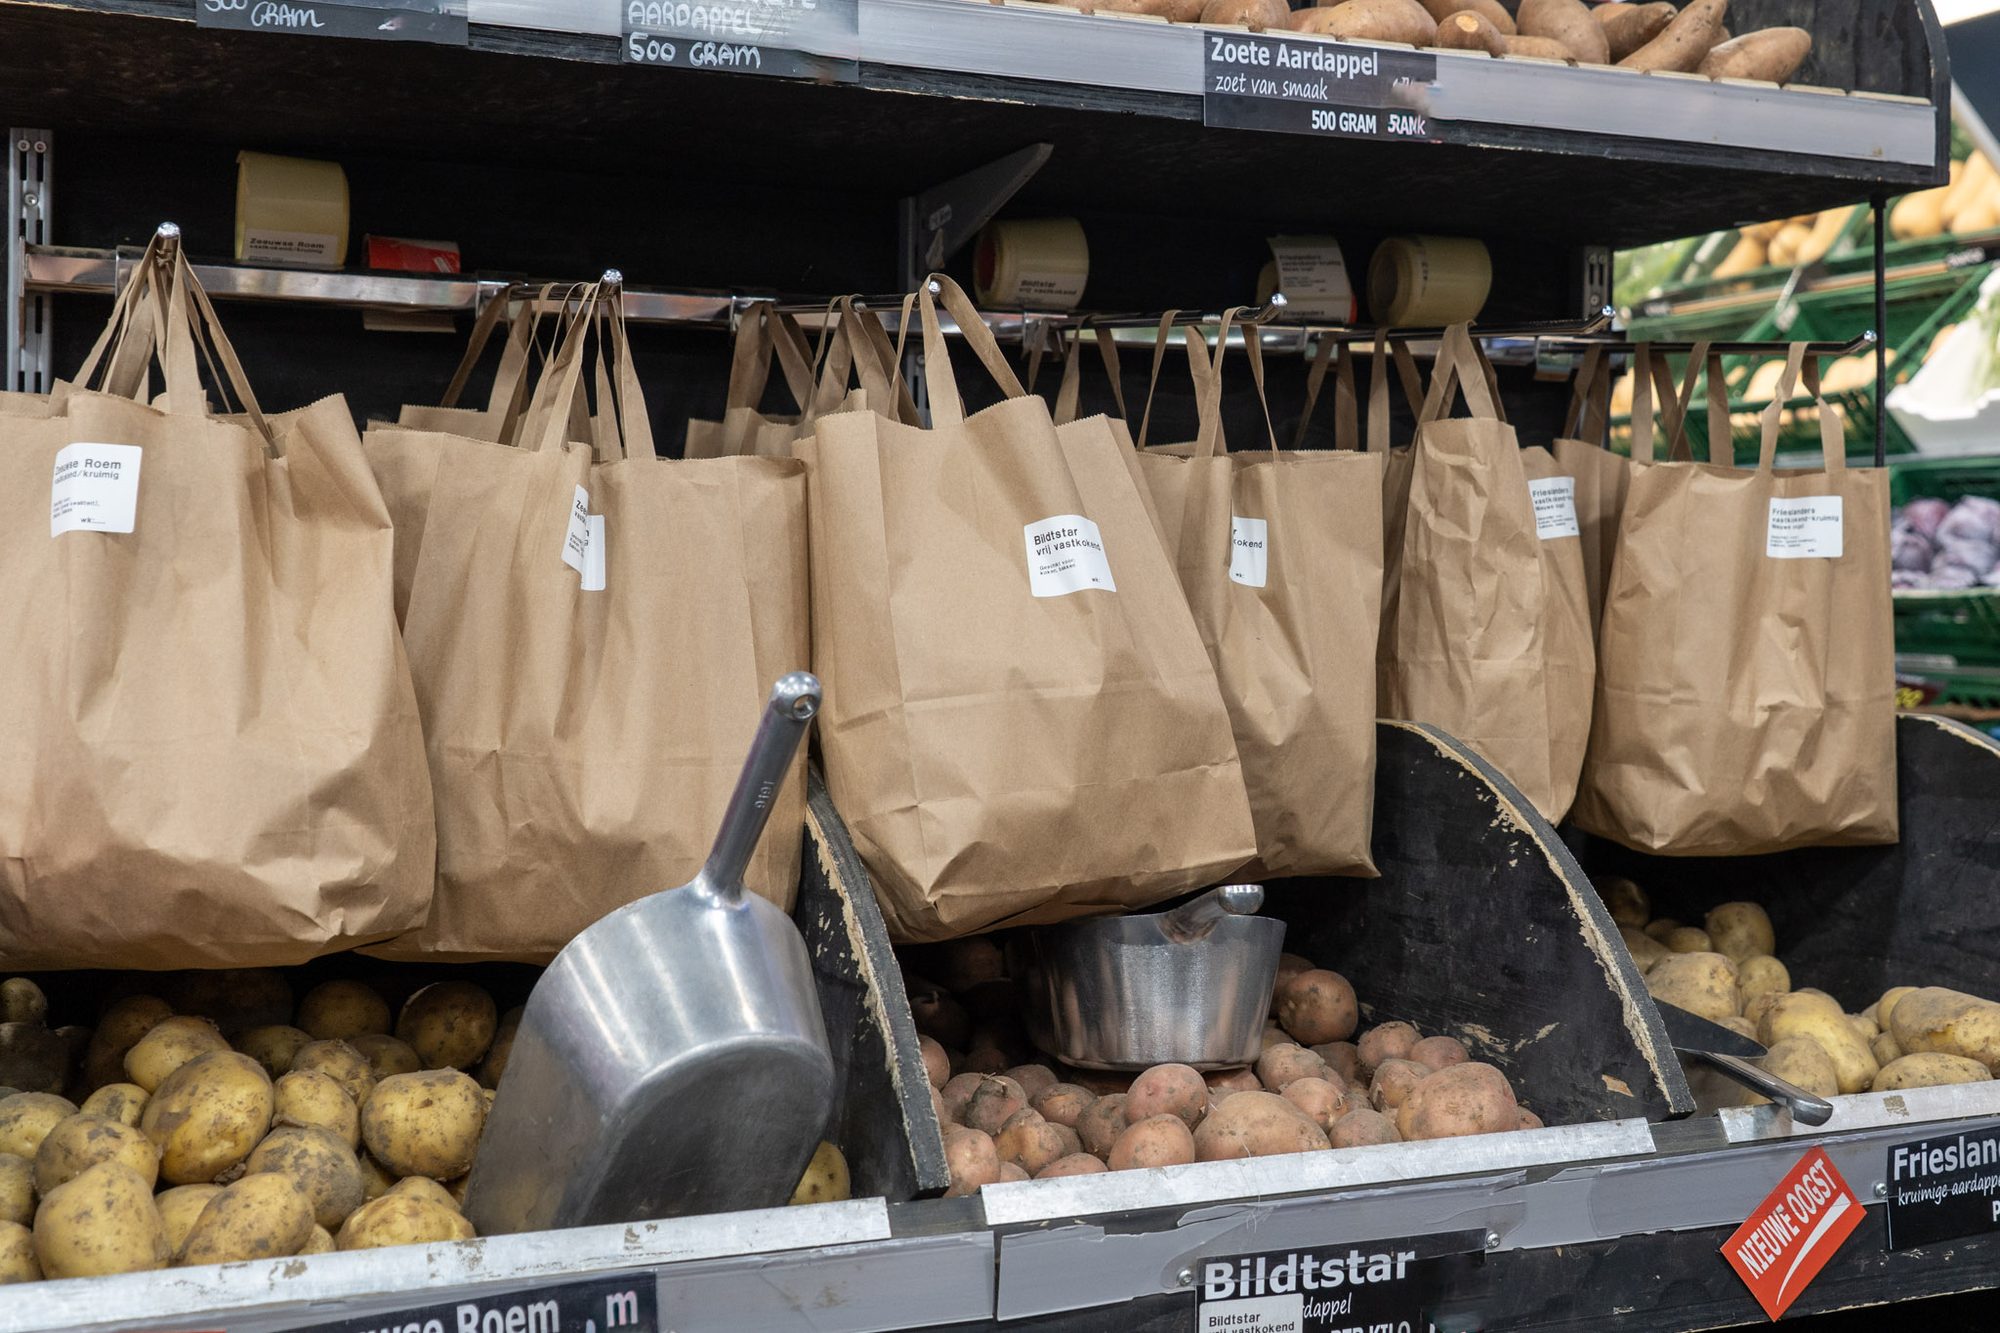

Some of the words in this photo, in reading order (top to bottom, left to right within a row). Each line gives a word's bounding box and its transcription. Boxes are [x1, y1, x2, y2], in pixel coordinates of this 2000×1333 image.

[250, 1, 325, 27] GRAM
[627, 1, 764, 35] AARDAPPEL
[629, 31, 677, 62] 500
[688, 41, 761, 69] GRAM
[1211, 37, 1271, 67] Zoete
[1276, 43, 1378, 80] Aardappel
[1215, 73, 1247, 93] zoet
[1251, 78, 1278, 95] van
[1282, 78, 1328, 100] smaak
[1311, 110, 1336, 131] 500
[1338, 112, 1377, 134] GRAM
[84, 458, 122, 469] Roem
[1034, 527, 1078, 546] Bildtstar
[1036, 545, 1052, 556] vrij
[1894, 1135, 2000, 1181] Frieslan
[1898, 1181, 1948, 1206] kruimige
[1736, 1203, 1801, 1280] NIEUWE
[1786, 1158, 1837, 1224] OOGST
[1204, 1249, 1416, 1301] Bildtstar
[456, 1300, 559, 1333] Roem
[1208, 1313, 1261, 1327] Bildtstar
